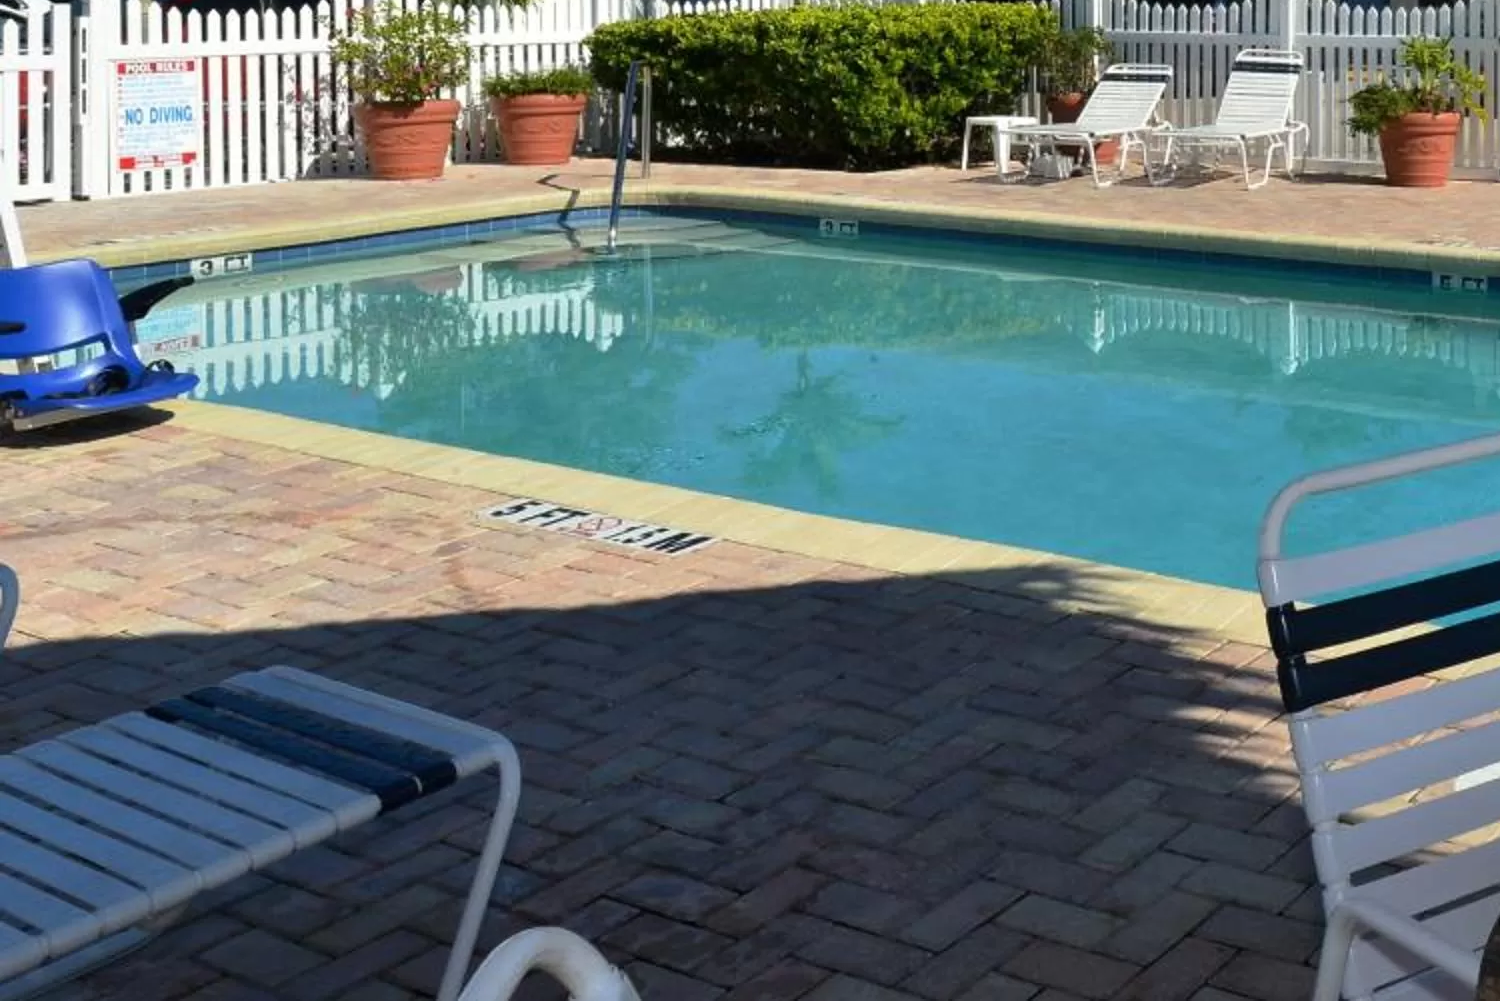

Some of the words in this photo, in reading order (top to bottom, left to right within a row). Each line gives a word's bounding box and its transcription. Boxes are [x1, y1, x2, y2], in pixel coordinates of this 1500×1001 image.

[124, 107, 144, 125] NO
[150, 105, 193, 123] DIVING
[200, 260, 213, 276] 3
[518, 506, 592, 528] FT
